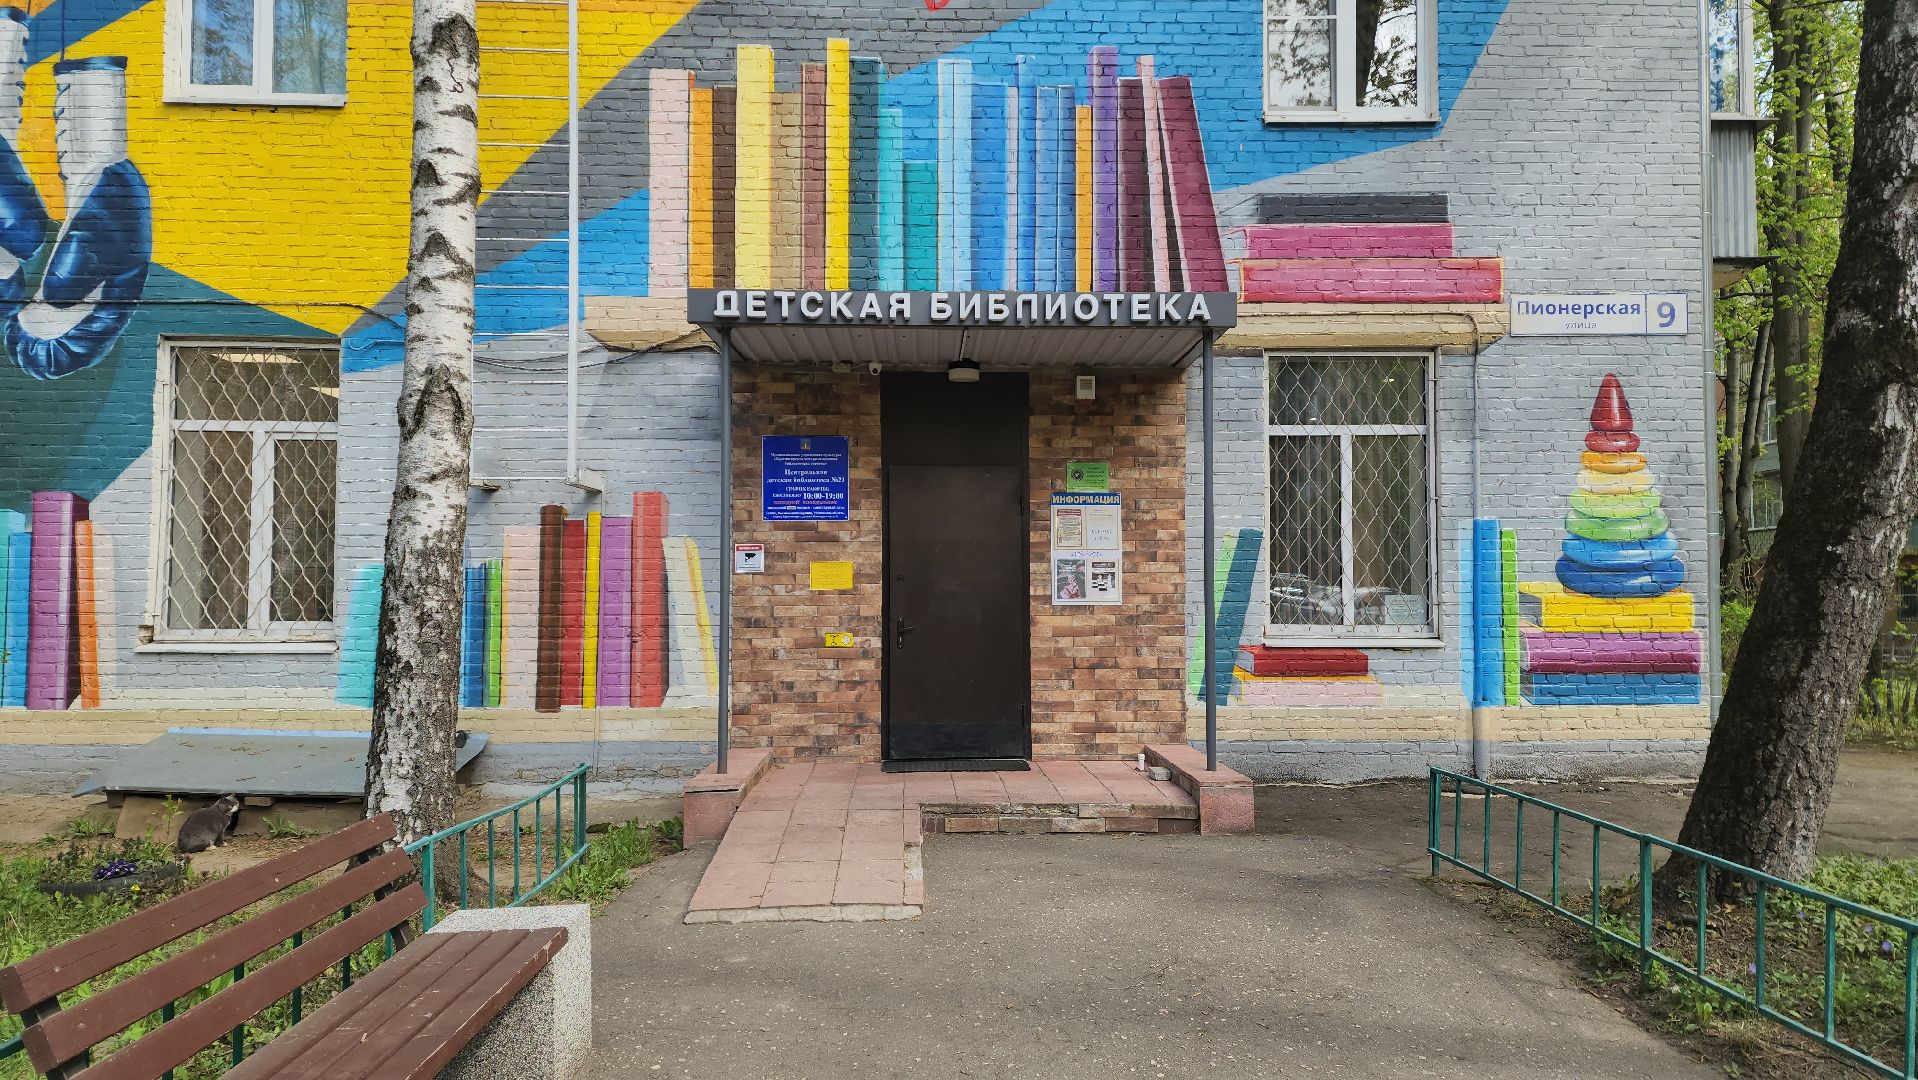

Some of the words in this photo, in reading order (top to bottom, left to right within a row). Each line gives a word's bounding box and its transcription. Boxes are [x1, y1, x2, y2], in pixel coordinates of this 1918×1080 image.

[713, 290, 912, 320] ДЕТСКАЯ
[930, 291, 1212, 323] БИБЛИОТЕКА
[1517, 300, 1641, 319] Пионерская
[1656, 301, 1676, 328] 9
[1565, 321, 1597, 330] улица
[1052, 495, 1120, 505] ИНФОРМАЦИЯ
